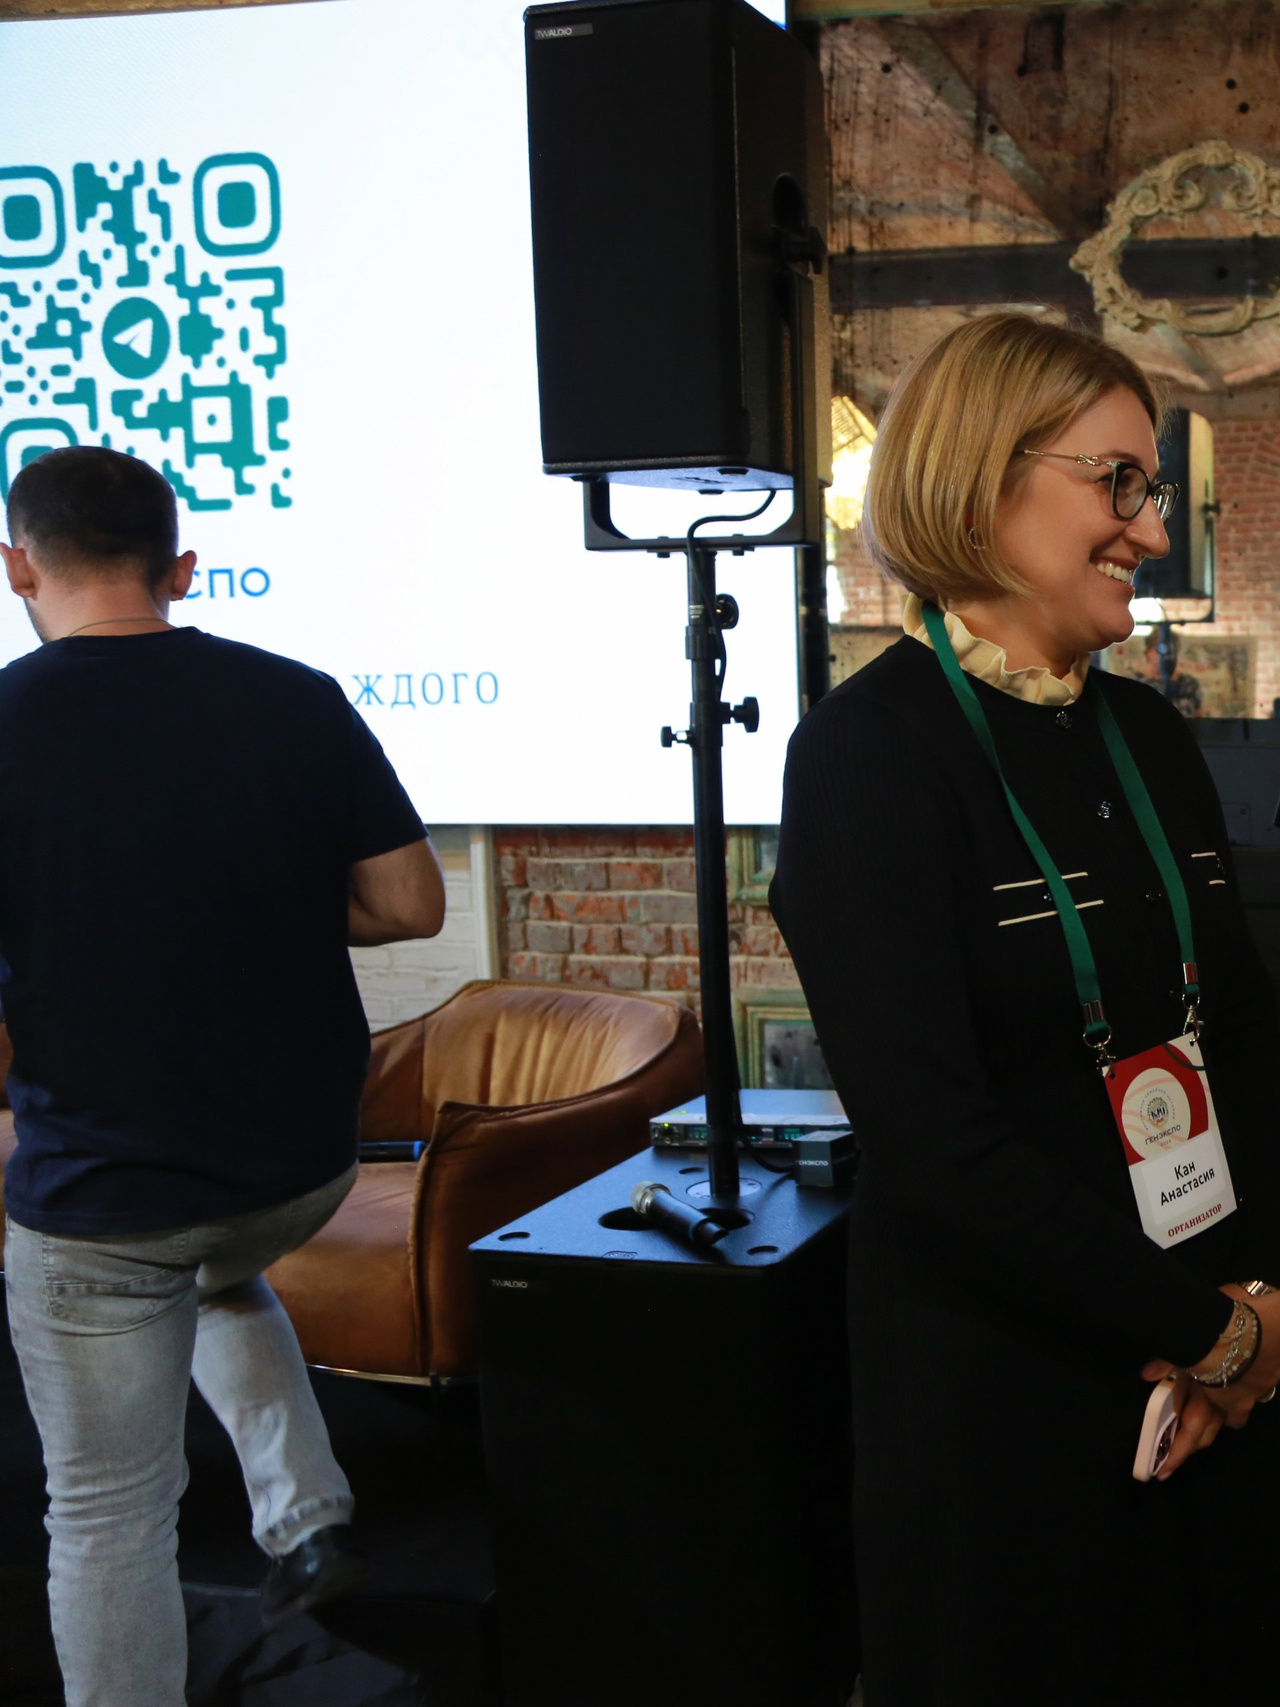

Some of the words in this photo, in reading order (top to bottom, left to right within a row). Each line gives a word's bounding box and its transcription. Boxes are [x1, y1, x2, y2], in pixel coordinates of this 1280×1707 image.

[352, 671, 499, 709] ЖДОГО
[1145, 1124, 1182, 1146] ГЕНЭКСПО
[1160, 1168, 1215, 1206] Анастасия
[1174, 1161, 1196, 1180] Кан
[1168, 1203, 1222, 1237] ОРГАНИЗАТОР
